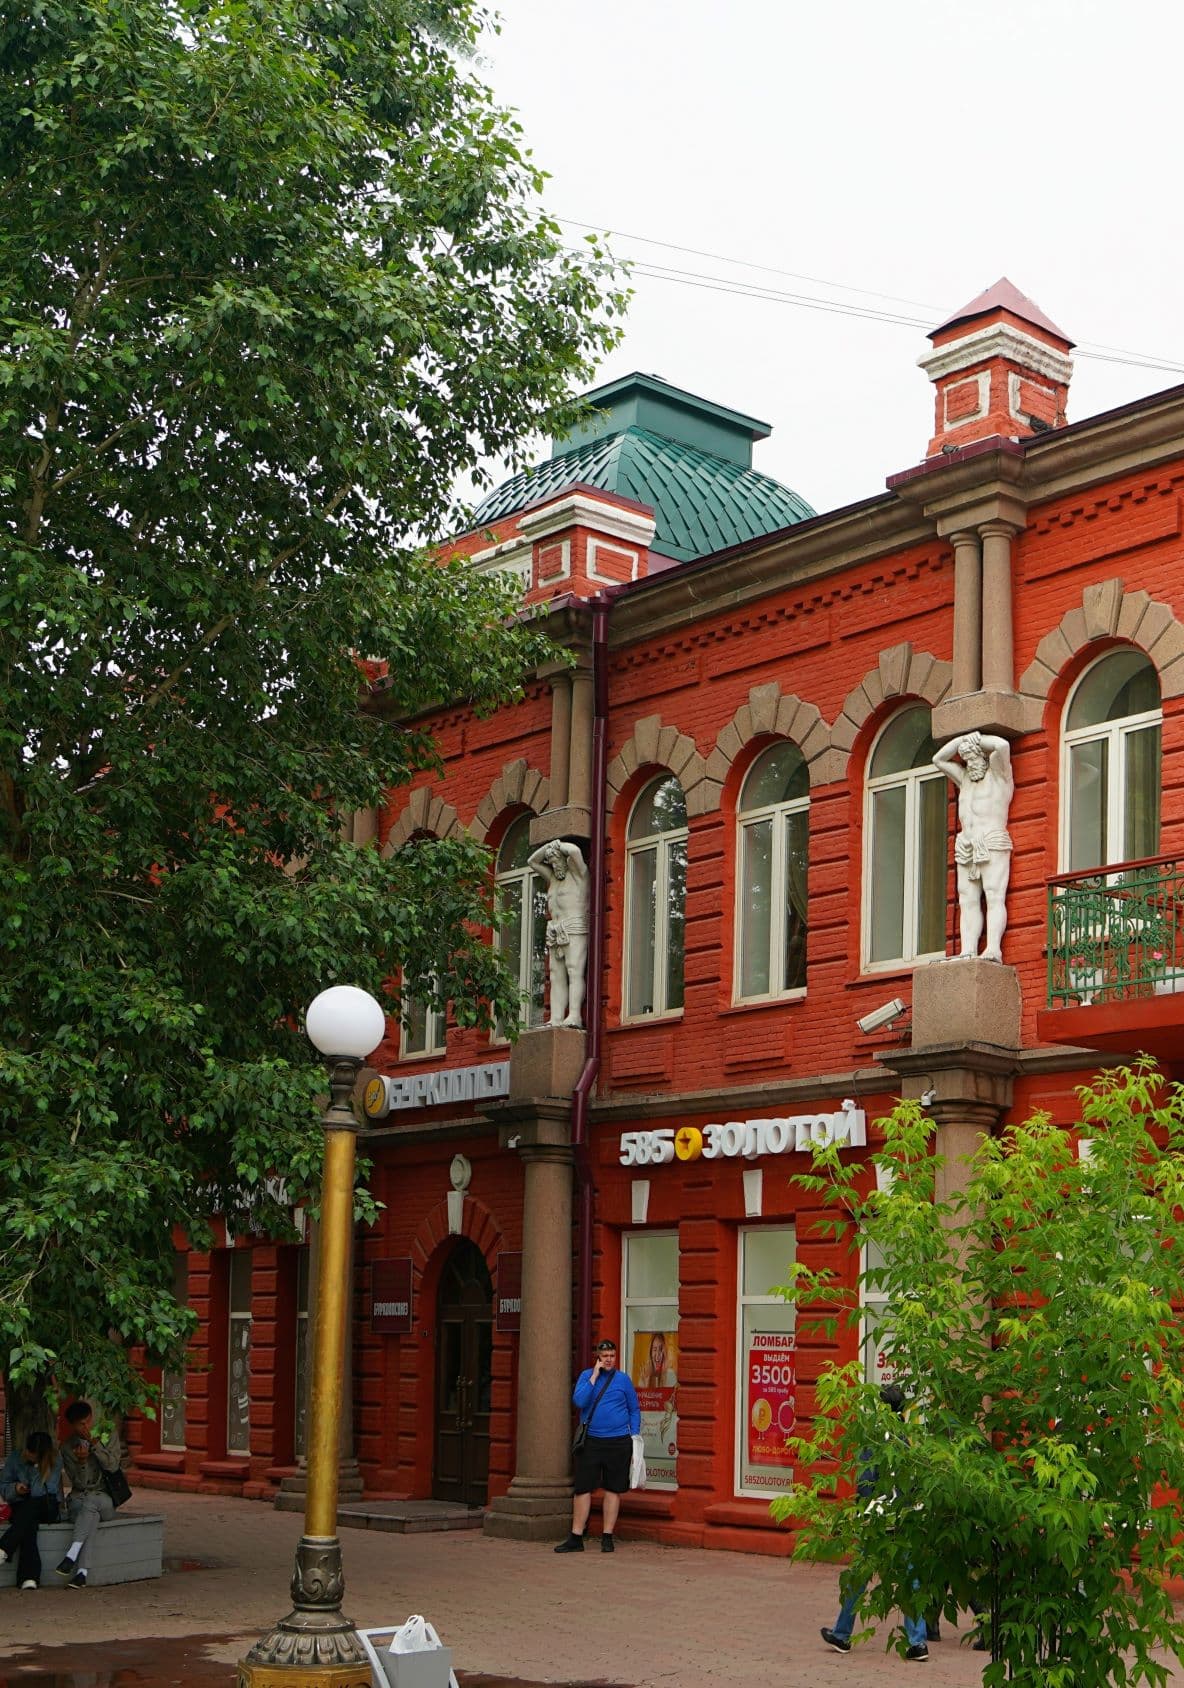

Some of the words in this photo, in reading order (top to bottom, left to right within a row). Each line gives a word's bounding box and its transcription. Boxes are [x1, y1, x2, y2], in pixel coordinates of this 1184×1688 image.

[619, 1129, 674, 1166] 585
[702, 1099, 866, 1159] ЗОЛОТОЙ
[753, 1335, 796, 1347] ЛОМБАР
[752, 1365, 792, 1385] 3500
